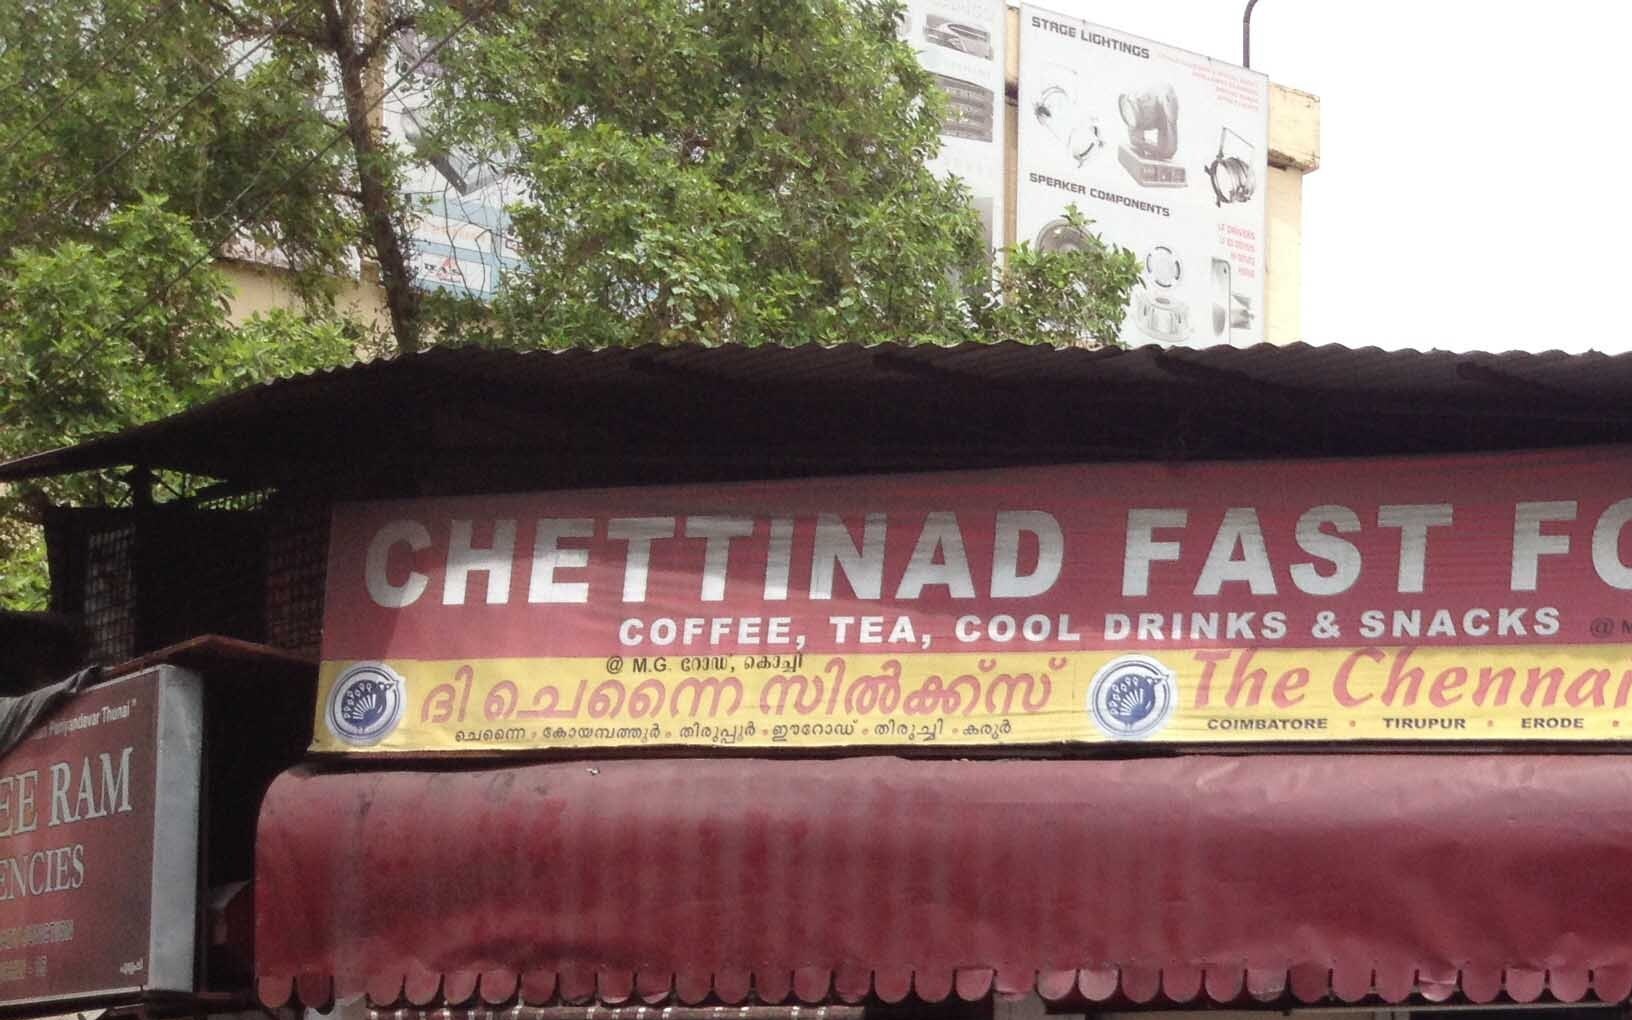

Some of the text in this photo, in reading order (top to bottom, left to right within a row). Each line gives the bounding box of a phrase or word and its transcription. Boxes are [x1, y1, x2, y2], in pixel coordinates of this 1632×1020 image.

[1031, 15, 1150, 60] STAGE LIGHTINGS
[1029, 172, 1171, 218] SPEAKER COMPONENTS
[363, 508, 1066, 607] CHETTINAD
[1120, 501, 1454, 598] FAST
[618, 607, 1561, 650] COFFEE, TEA, COOL DRINKS & SNACKS
[1590, 617, 1615, 639] @
[606, 656, 623, 674] @
[632, 657, 672, 673] M.G.
[744, 652, 803, 673] കൊച്ചി
[1190, 648, 1310, 709] The
[420, 664, 474, 723] ദി
[455, 727, 526, 743] ചെന്നൈ
[1207, 717, 1328, 730] COIMBATORE
[1383, 717, 1466, 729] TIRUPUR
[1521, 717, 1584, 729] ERODE
[48, 746, 134, 827] RAM
